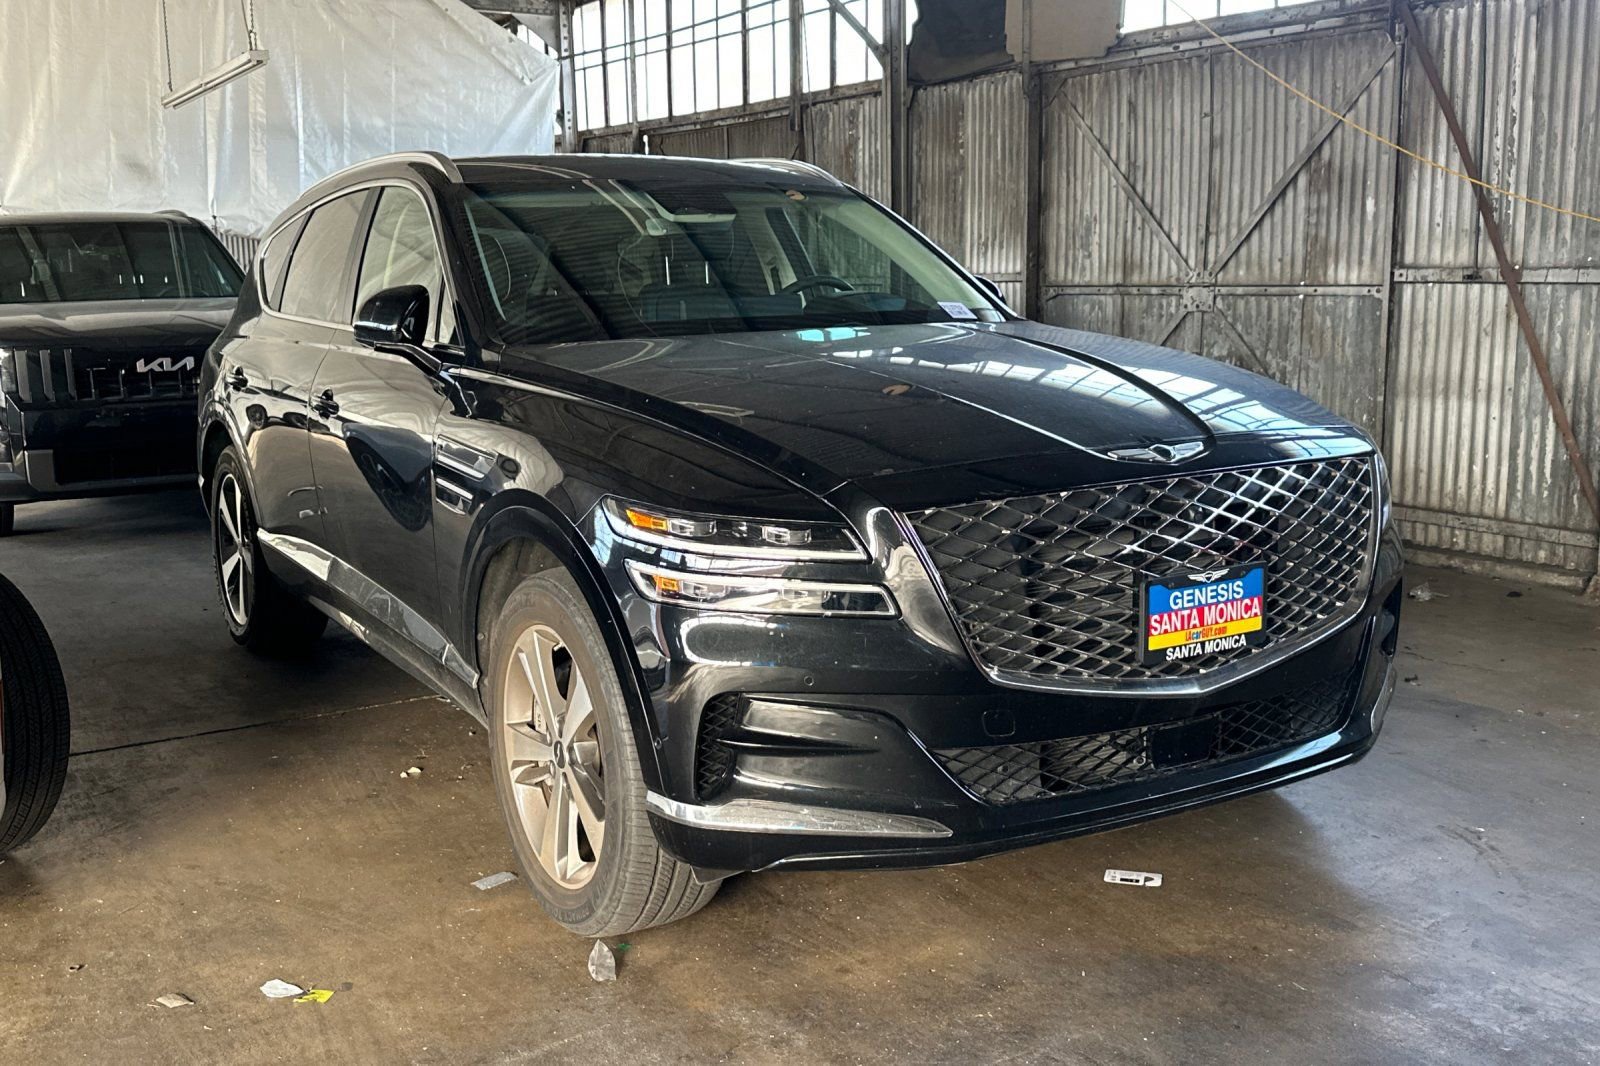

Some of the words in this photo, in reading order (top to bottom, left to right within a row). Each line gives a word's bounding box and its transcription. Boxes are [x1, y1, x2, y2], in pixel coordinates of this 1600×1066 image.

[136, 356, 195, 373] KIA
[1169, 581, 1244, 610] GENESIS
[1151, 609, 1200, 635] SANTA
[1203, 597, 1261, 625] MONICA
[1165, 643, 1201, 661] SANTA
[1204, 634, 1247, 651] MONICA
